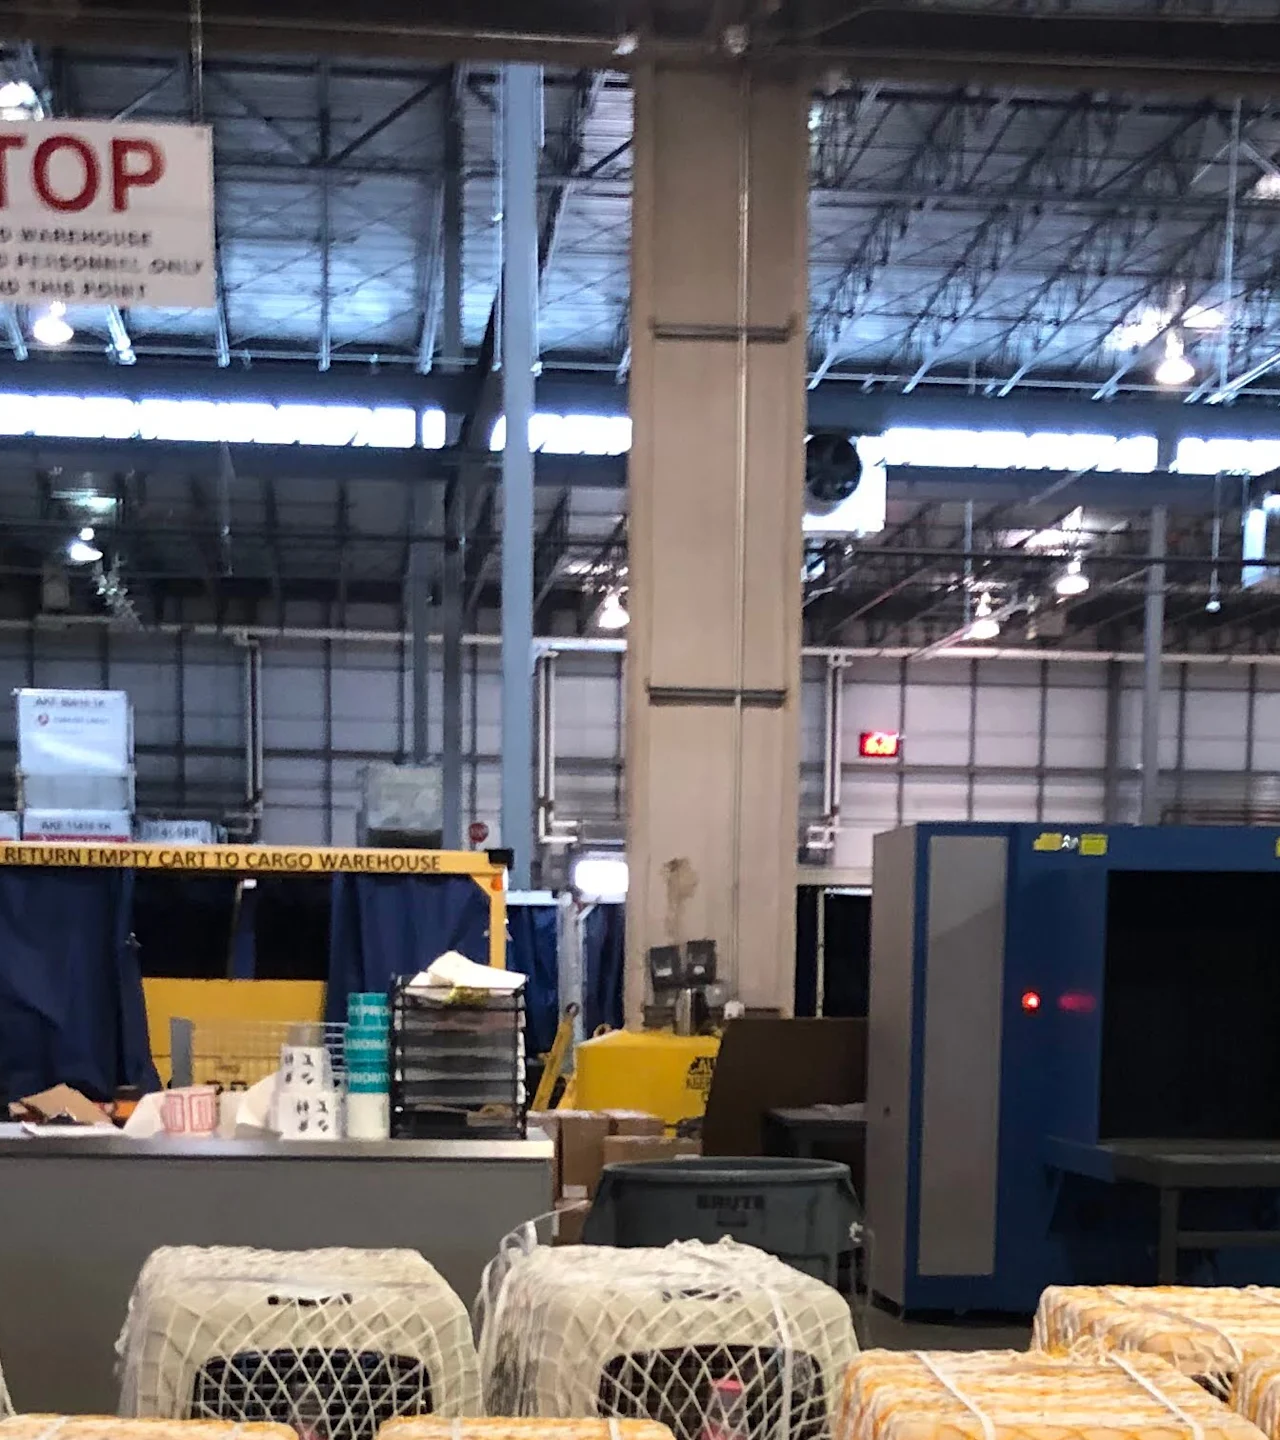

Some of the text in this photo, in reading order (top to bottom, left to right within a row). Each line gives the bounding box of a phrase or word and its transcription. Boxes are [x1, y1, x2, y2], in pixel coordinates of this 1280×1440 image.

[20, 226, 153, 249] WAREHOUSE
[150, 258, 205, 276] ONLY
[28, 279, 76, 297] THIS
[83, 280, 147, 299] POINT
[4, 846, 441, 872] RETURN EMPTY CART TO CARGO WAREHOUSE
